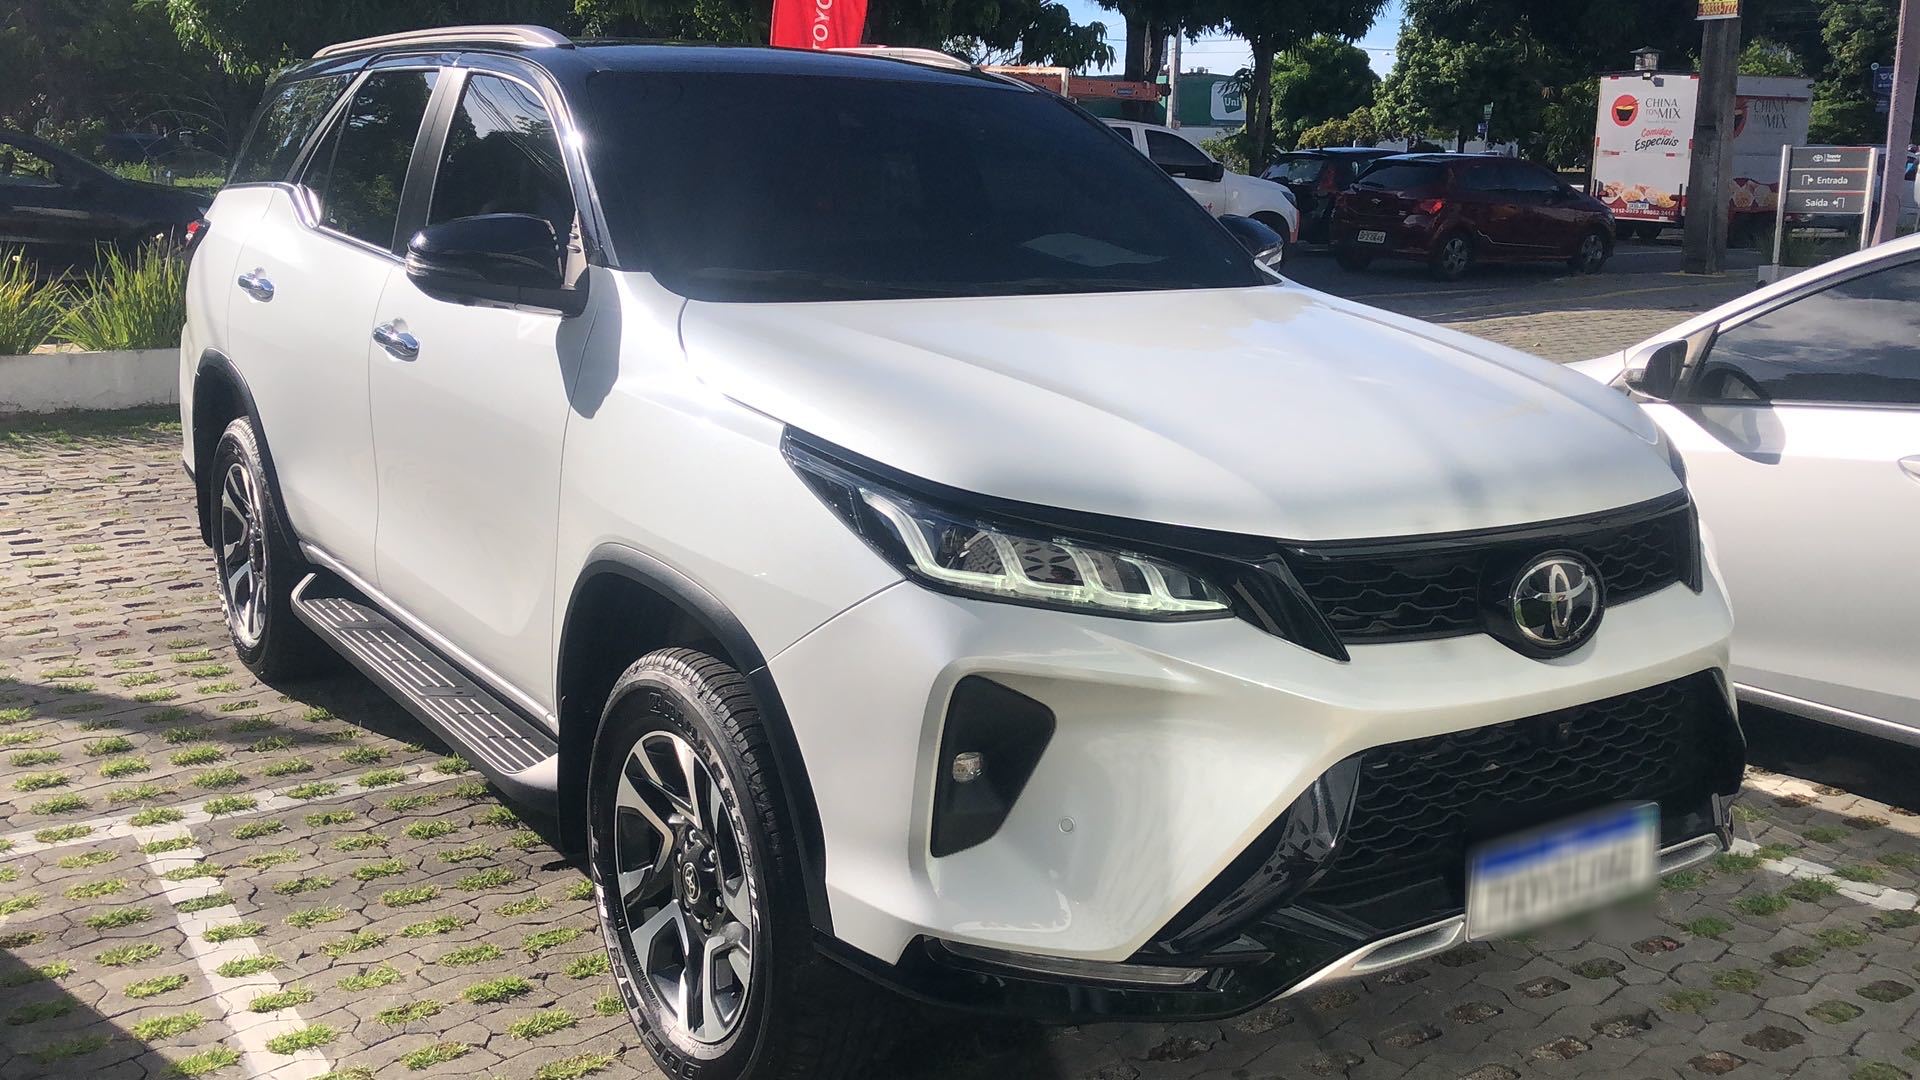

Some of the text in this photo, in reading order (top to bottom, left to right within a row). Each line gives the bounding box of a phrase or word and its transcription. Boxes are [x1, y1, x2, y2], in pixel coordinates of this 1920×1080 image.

[1224, 97, 1240, 106] Uni
[1645, 97, 1678, 108] CHINA
[1634, 136, 1679, 151] Especiais
[1817, 176, 1848, 184] Entrada
[1805, 198, 1828, 207] Saída
